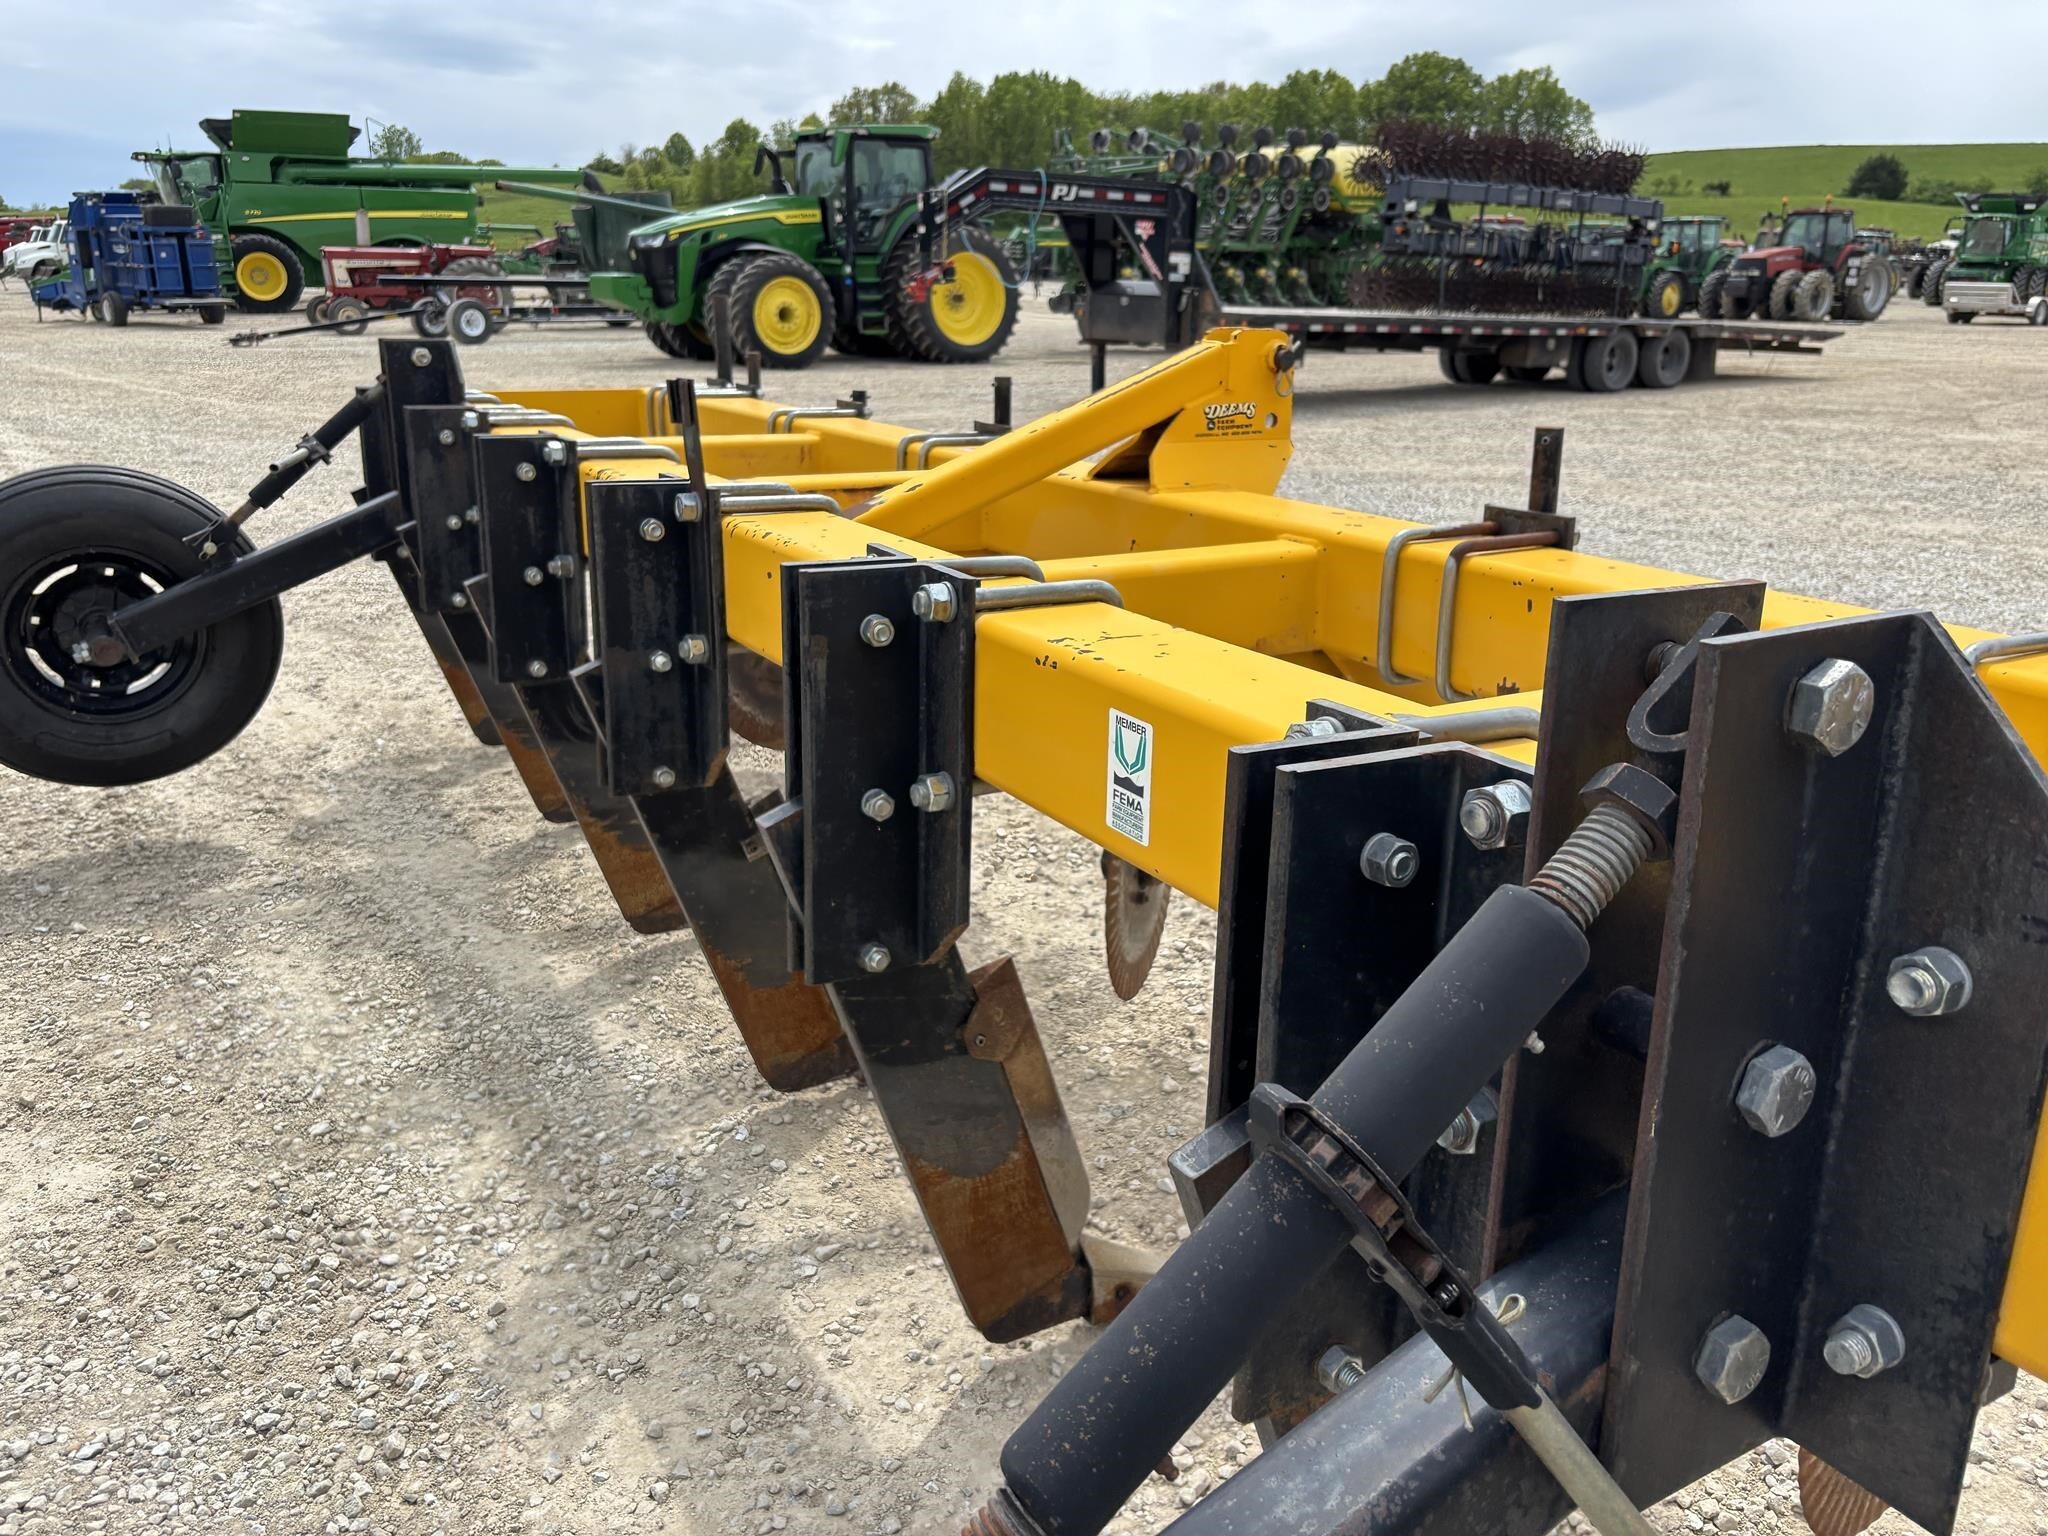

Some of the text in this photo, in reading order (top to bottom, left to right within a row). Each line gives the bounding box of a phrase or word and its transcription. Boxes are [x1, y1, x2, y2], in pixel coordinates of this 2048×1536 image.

[1051, 184, 1079, 201] PJ
[1204, 402, 1256, 419] DEEMS
[1115, 715, 1147, 737] MEMBER
[1112, 788, 1144, 815] FEMA
[1112, 820, 1144, 840] ASSOCIATION
